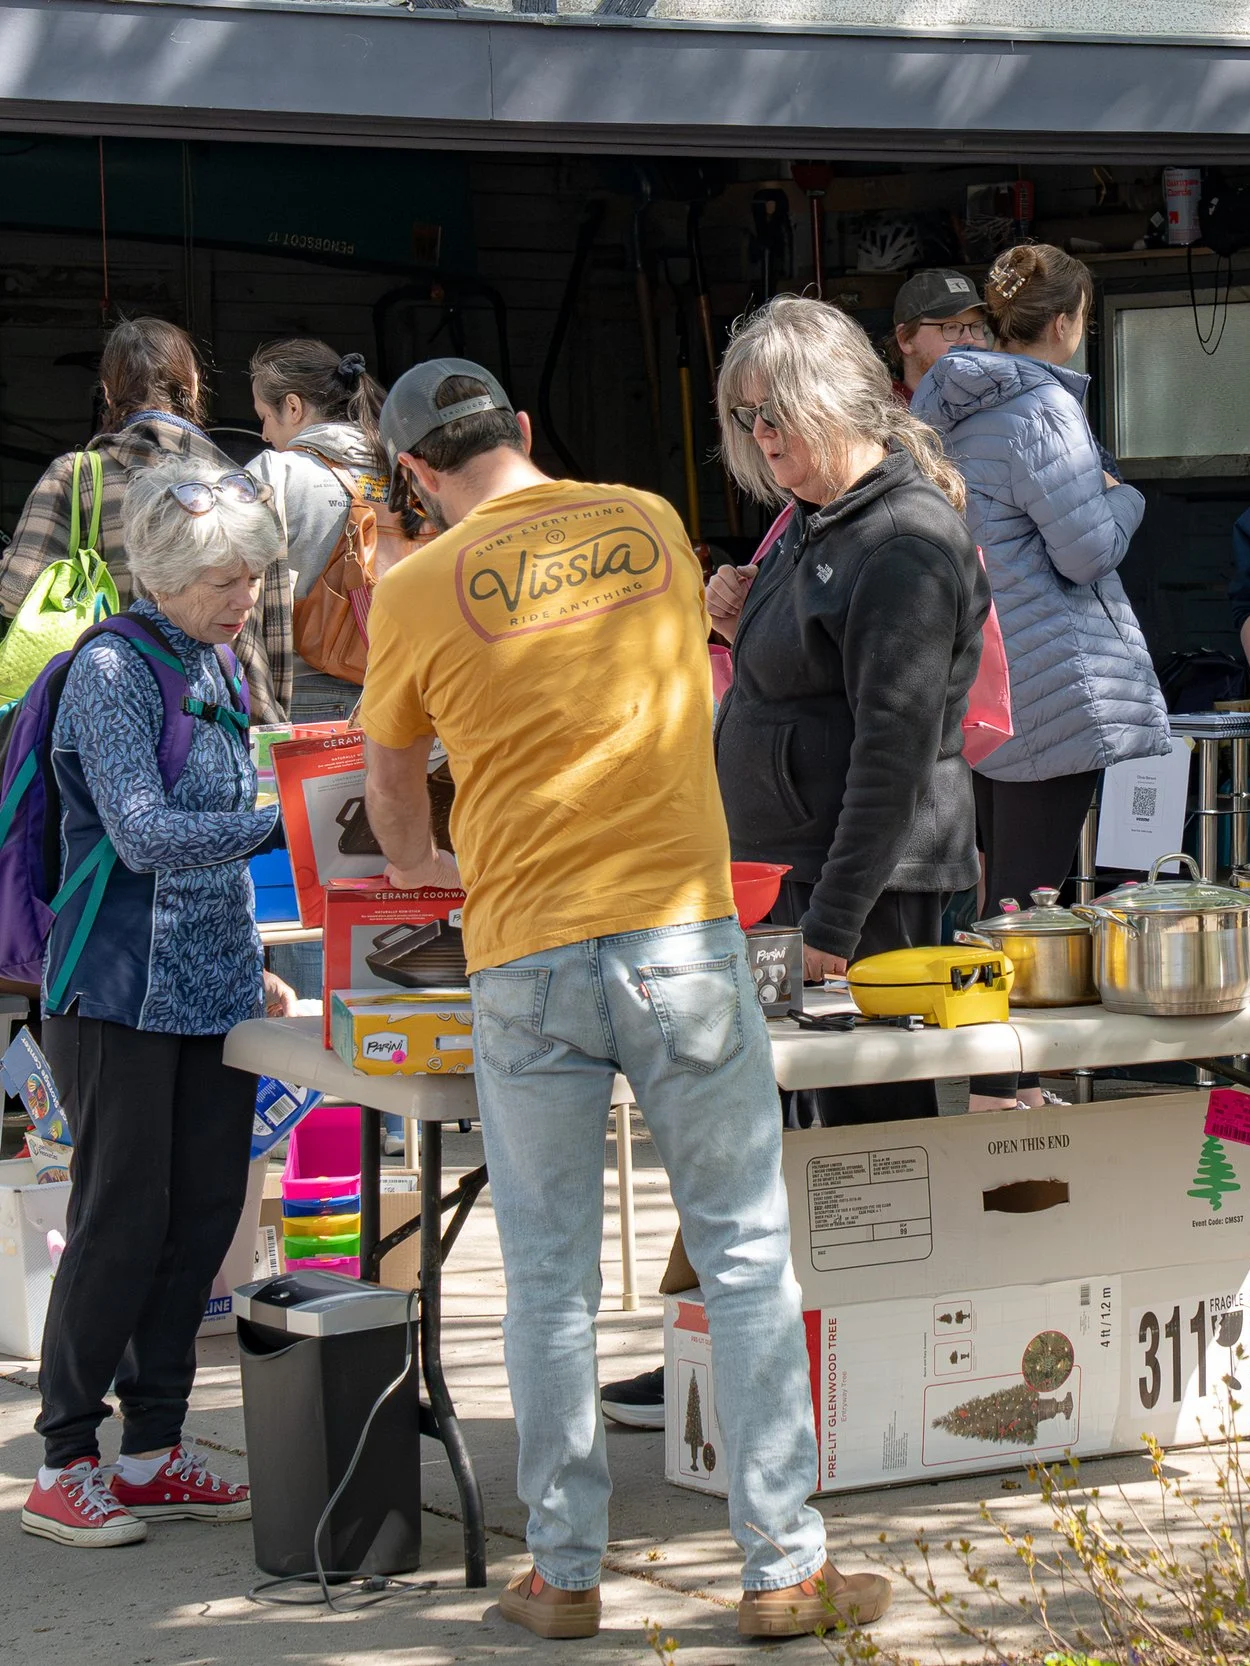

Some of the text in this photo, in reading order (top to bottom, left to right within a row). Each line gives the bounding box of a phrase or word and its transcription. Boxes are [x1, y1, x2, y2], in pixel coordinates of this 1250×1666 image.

[282, 233, 355, 255] PENOBSCOT
[475, 505, 626, 558] SURF EVERYTHING
[469, 526, 660, 613] Vissla
[510, 581, 644, 627] RIDE ANYTHING
[323, 735, 364, 749] CERAM
[375, 891, 466, 900] CERAMIC COOKWA
[988, 1134, 1070, 1155] OPEN THIS END
[1192, 1215, 1244, 1228] Event Code: CMS37
[1102, 1287, 1111, 1298] m
[1101, 1301, 1111, 1318] 1.2
[1210, 1293, 1244, 1313] FRAGILE
[1101, 1328, 1111, 1339] ft
[1101, 1340, 1110, 1348] 4
[1138, 1300, 1207, 1409] 311
[828, 1317, 837, 1479] PRE-LIT GLENWOOD TREE
